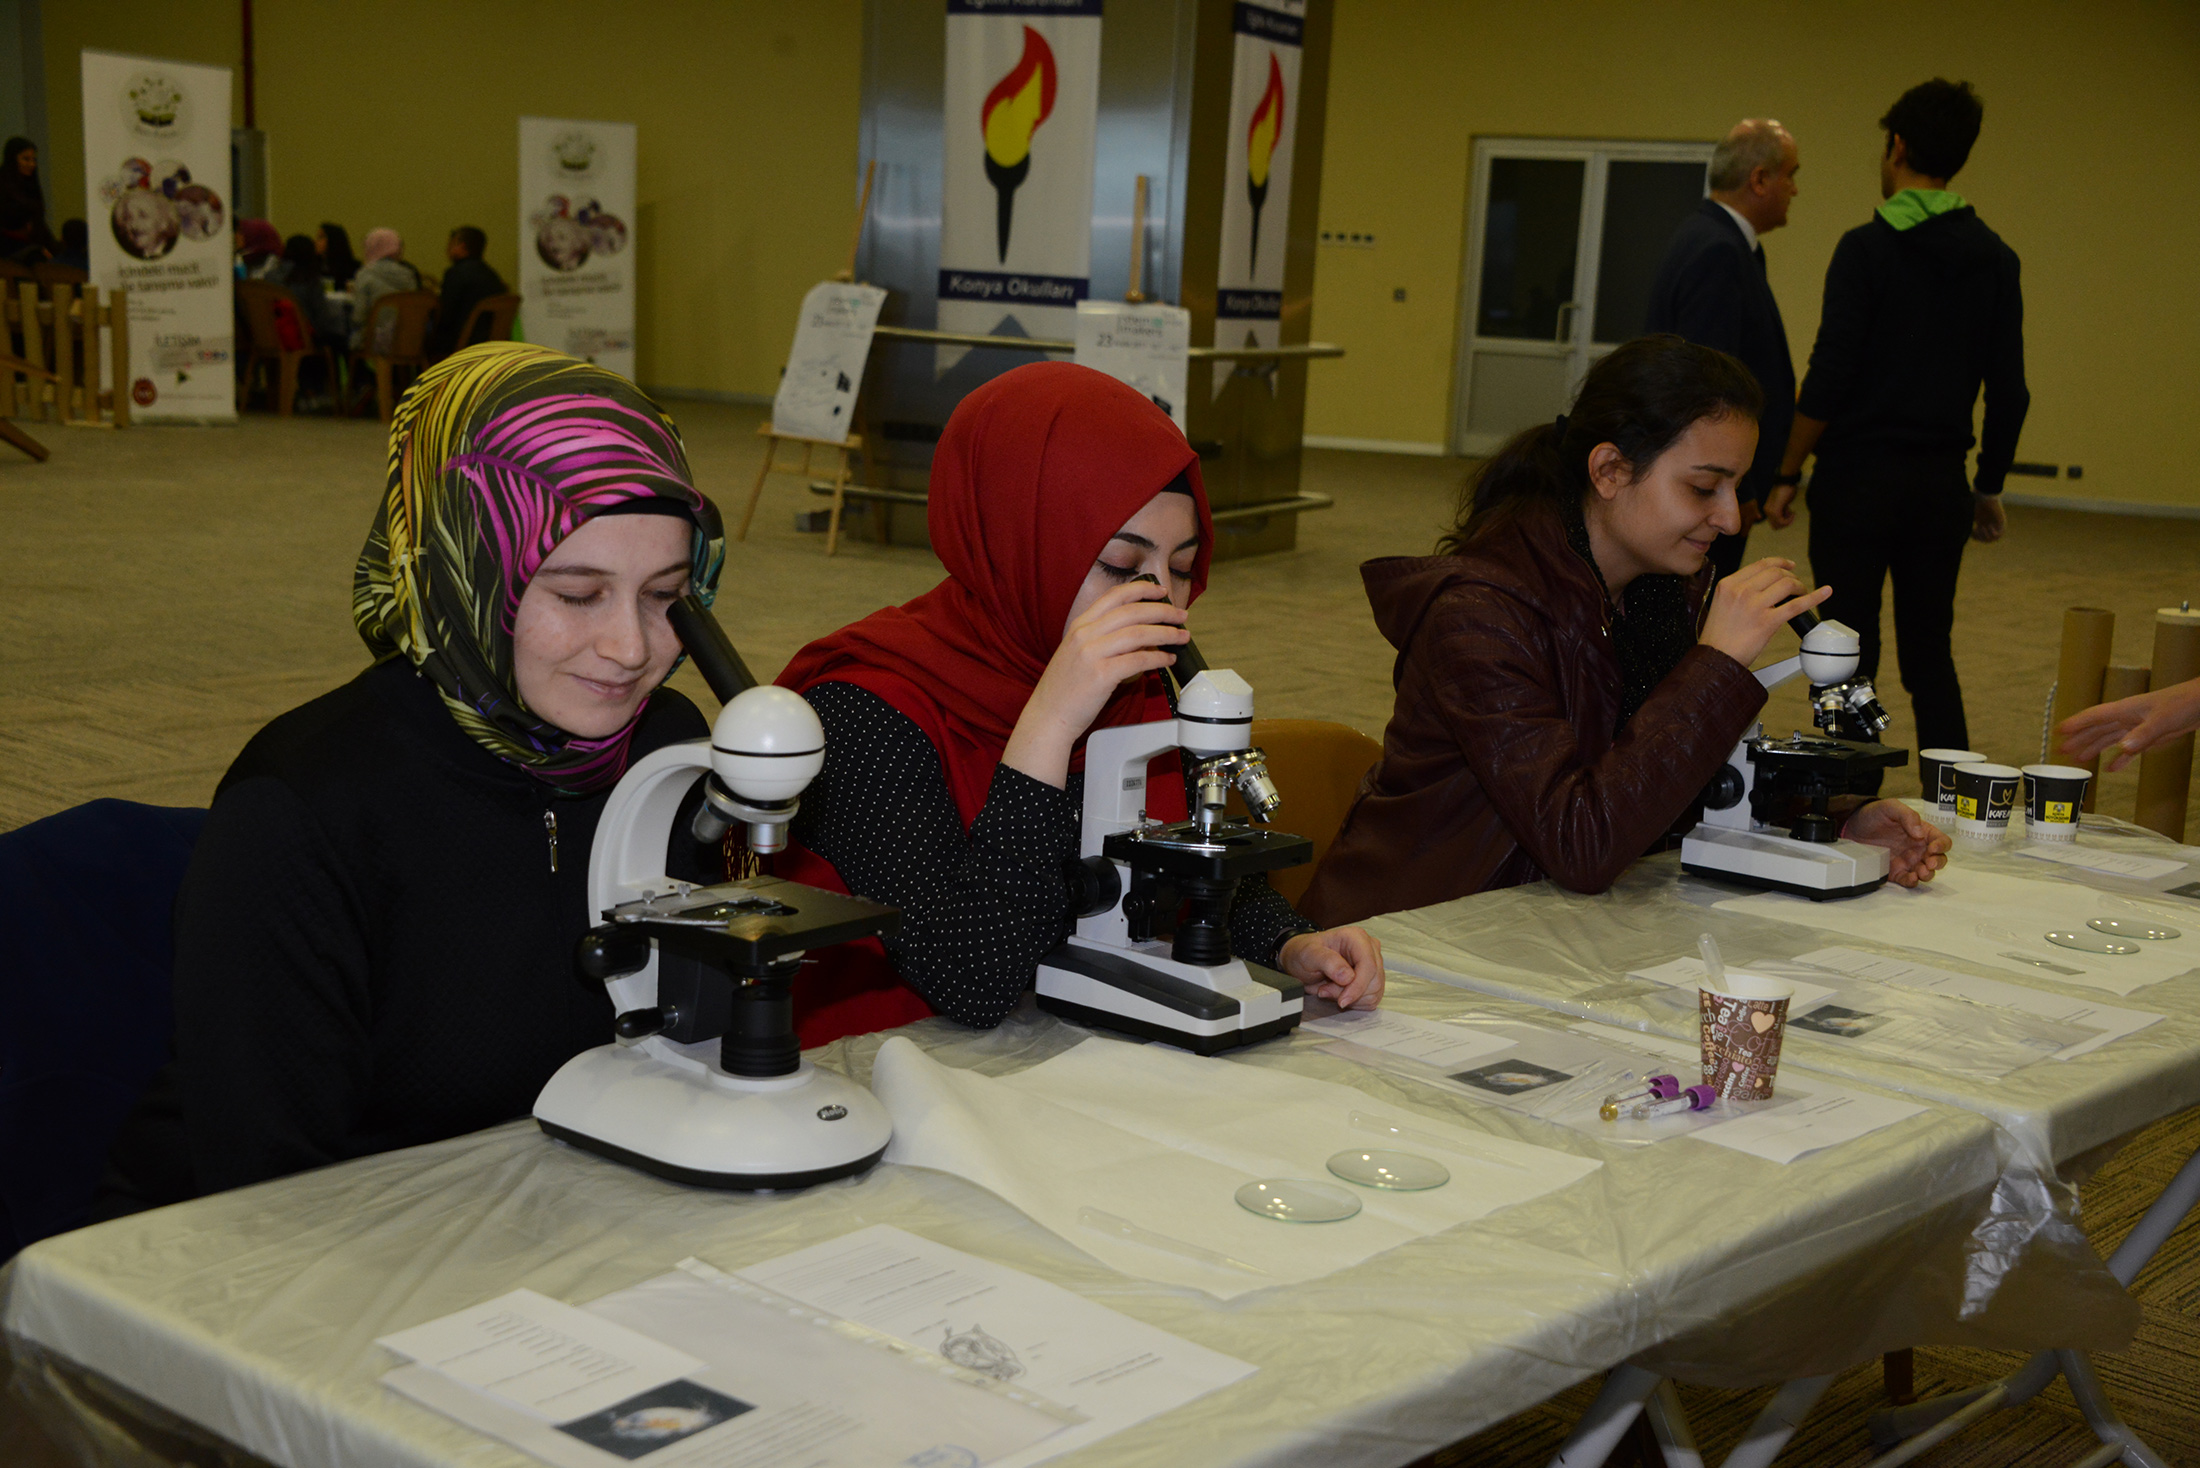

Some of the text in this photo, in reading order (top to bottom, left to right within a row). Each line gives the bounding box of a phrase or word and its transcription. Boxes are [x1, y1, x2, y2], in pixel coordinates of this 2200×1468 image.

[949, 274, 1075, 299] Konya Okulları
[1717, 1001, 1738, 1026] Tea
[1738, 1046, 1753, 1058] Tea
[1738, 1066, 1751, 1087] Coffee
